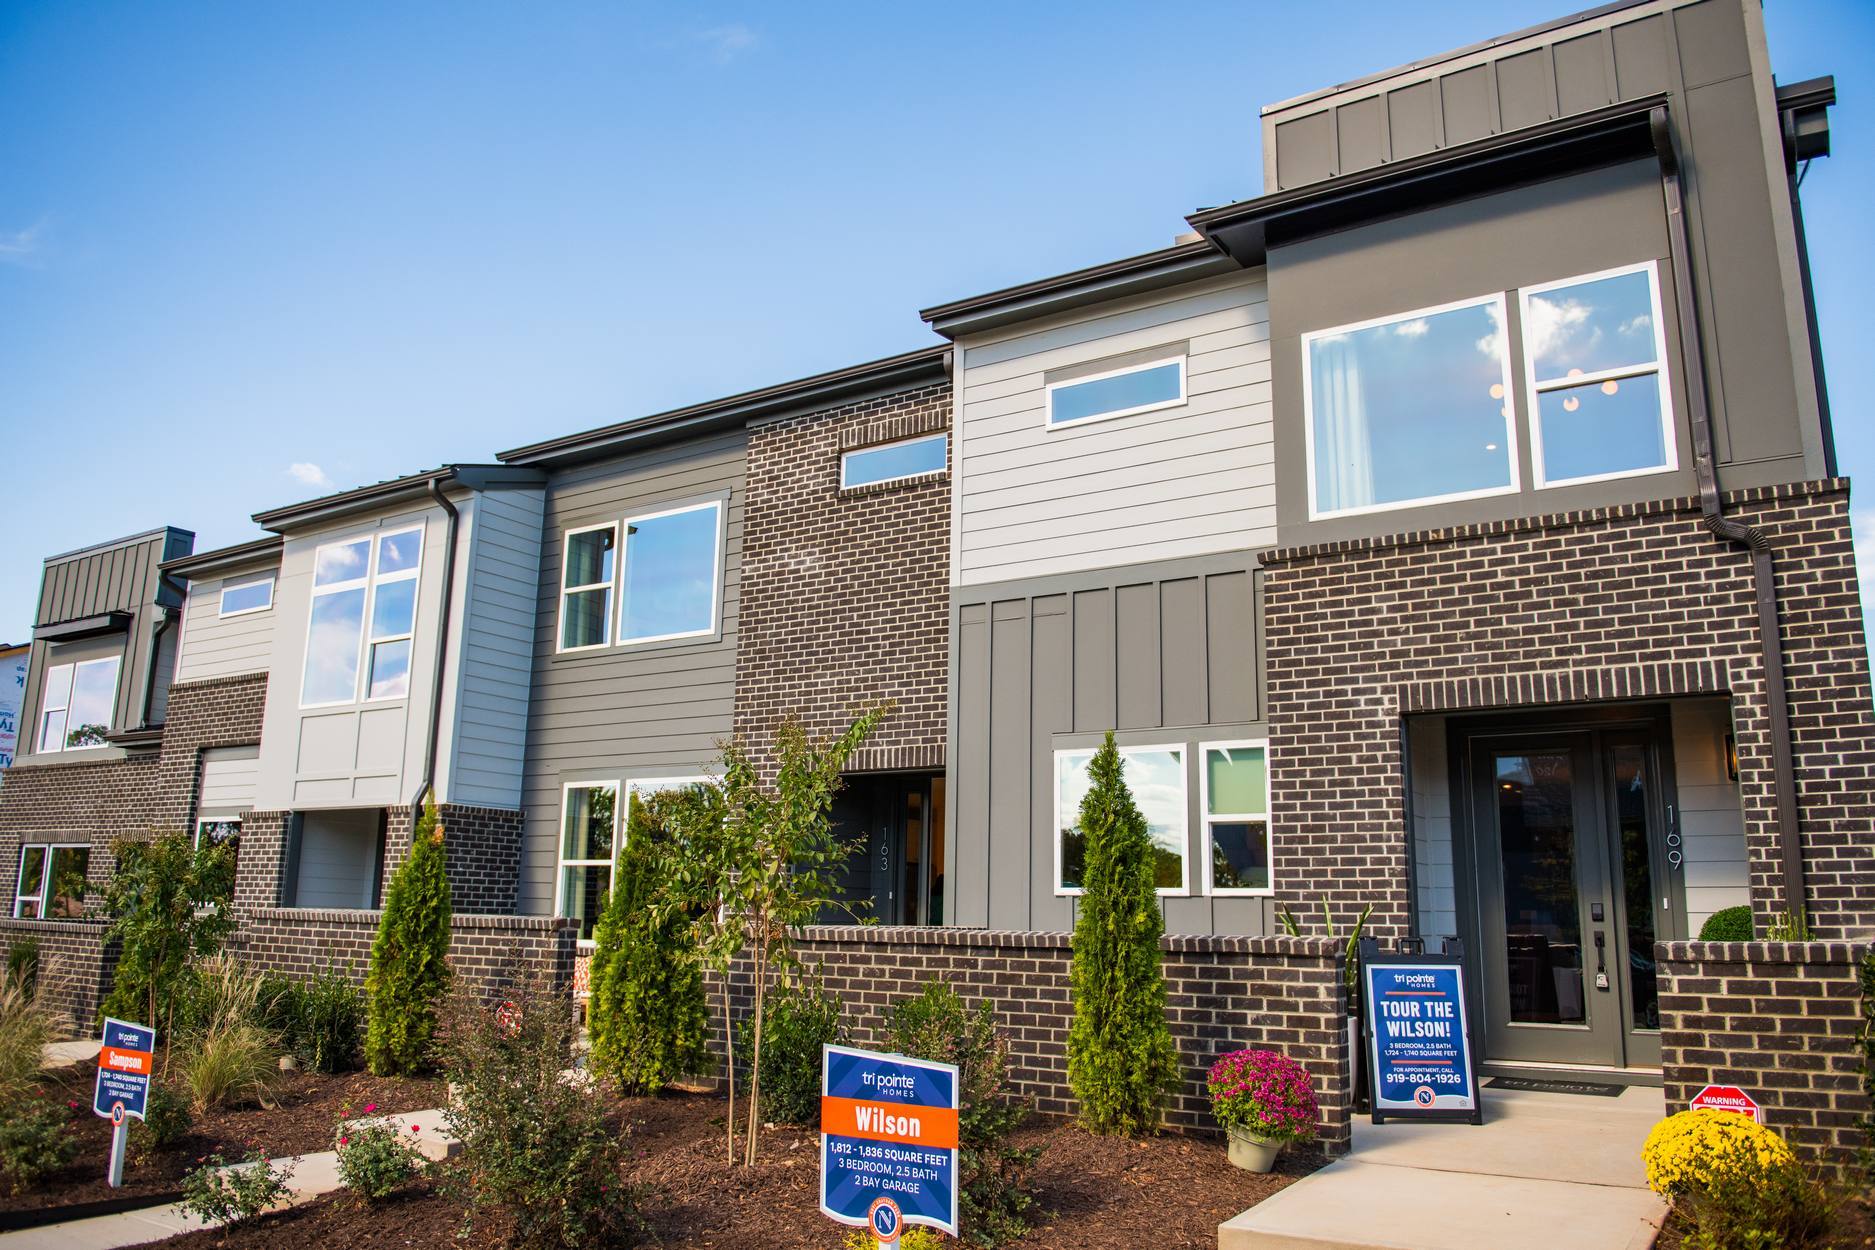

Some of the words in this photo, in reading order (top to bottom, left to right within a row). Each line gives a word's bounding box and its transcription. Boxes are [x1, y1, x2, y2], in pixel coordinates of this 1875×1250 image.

[1666, 804, 1682, 870] 169
[881, 826, 889, 871] 163
[1394, 974, 1405, 982] tri
[1406, 973, 1435, 986] pointe
[1380, 1001, 1420, 1018] TOUR
[1423, 1002, 1454, 1018] THE
[1386, 1021, 1451, 1038] WILSON!
[109, 1050, 143, 1070] Sampson
[862, 1071, 875, 1085] tri
[877, 1073, 914, 1090] pointe
[1386, 1074, 1461, 1084] 919-804-1926
[883, 1088, 914, 1098] HOMES
[1702, 1096, 1746, 1106] WARNING
[855, 1105, 920, 1138] Wilson
[830, 1141, 852, 1155] 1,812
[859, 1145, 883, 1158] 1,836
[885, 1149, 922, 1164] SQUARE
[924, 1153, 948, 1167] FEET
[838, 1158, 844, 1168] 3
[846, 1159, 894, 1176] BEDROOM,
[896, 1165, 910, 1177] 2.5
[912, 1167, 938, 1181] BATH
[855, 1175, 861, 1185] 2
[862, 1175, 880, 1188] BAY
[882, 1178, 920, 1194] GARAGE
